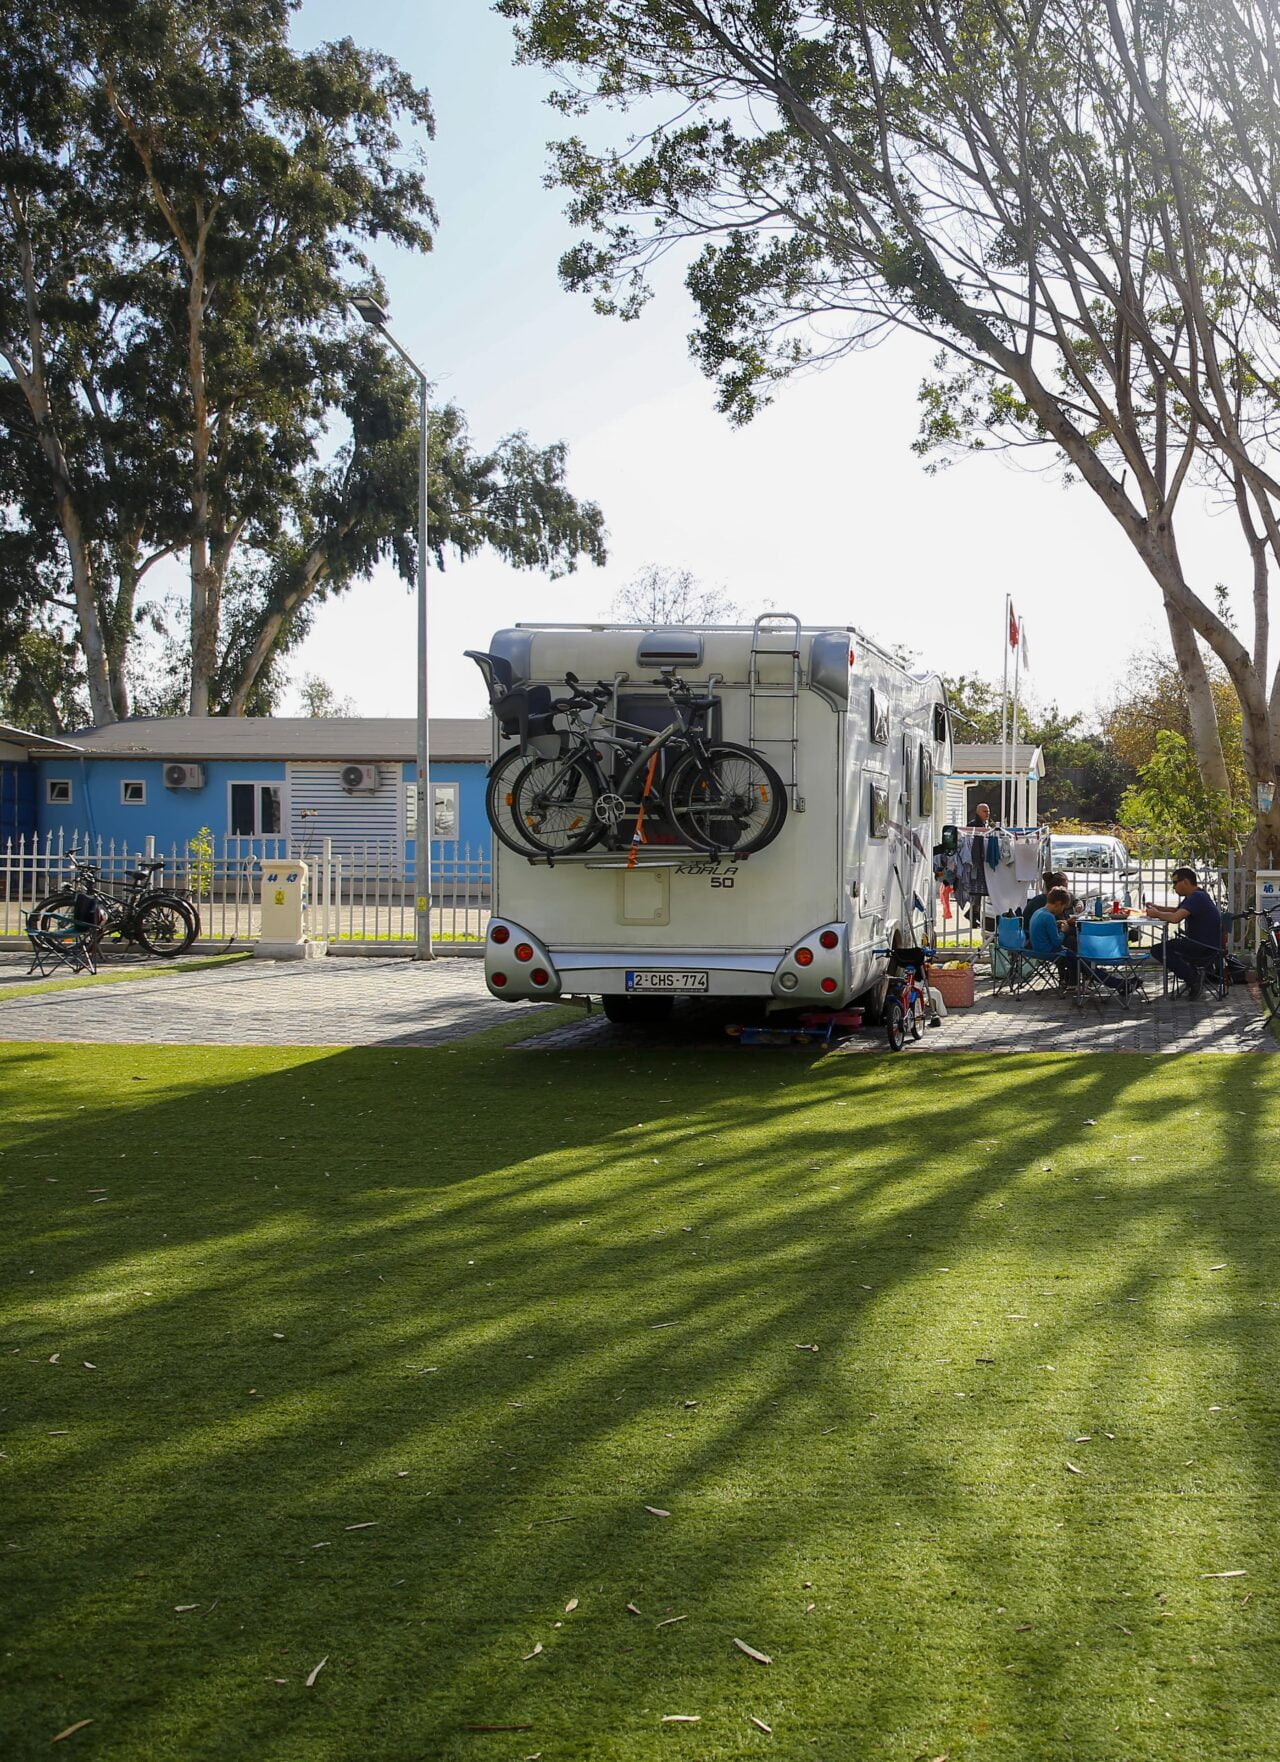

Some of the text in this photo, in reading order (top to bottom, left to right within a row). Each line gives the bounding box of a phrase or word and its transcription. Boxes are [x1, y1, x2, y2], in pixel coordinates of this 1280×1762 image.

[674, 866, 739, 876] KOALA
[267, 873, 298, 883] 44 43
[710, 877, 735, 889] 50
[1263, 884, 1274, 894] 46
